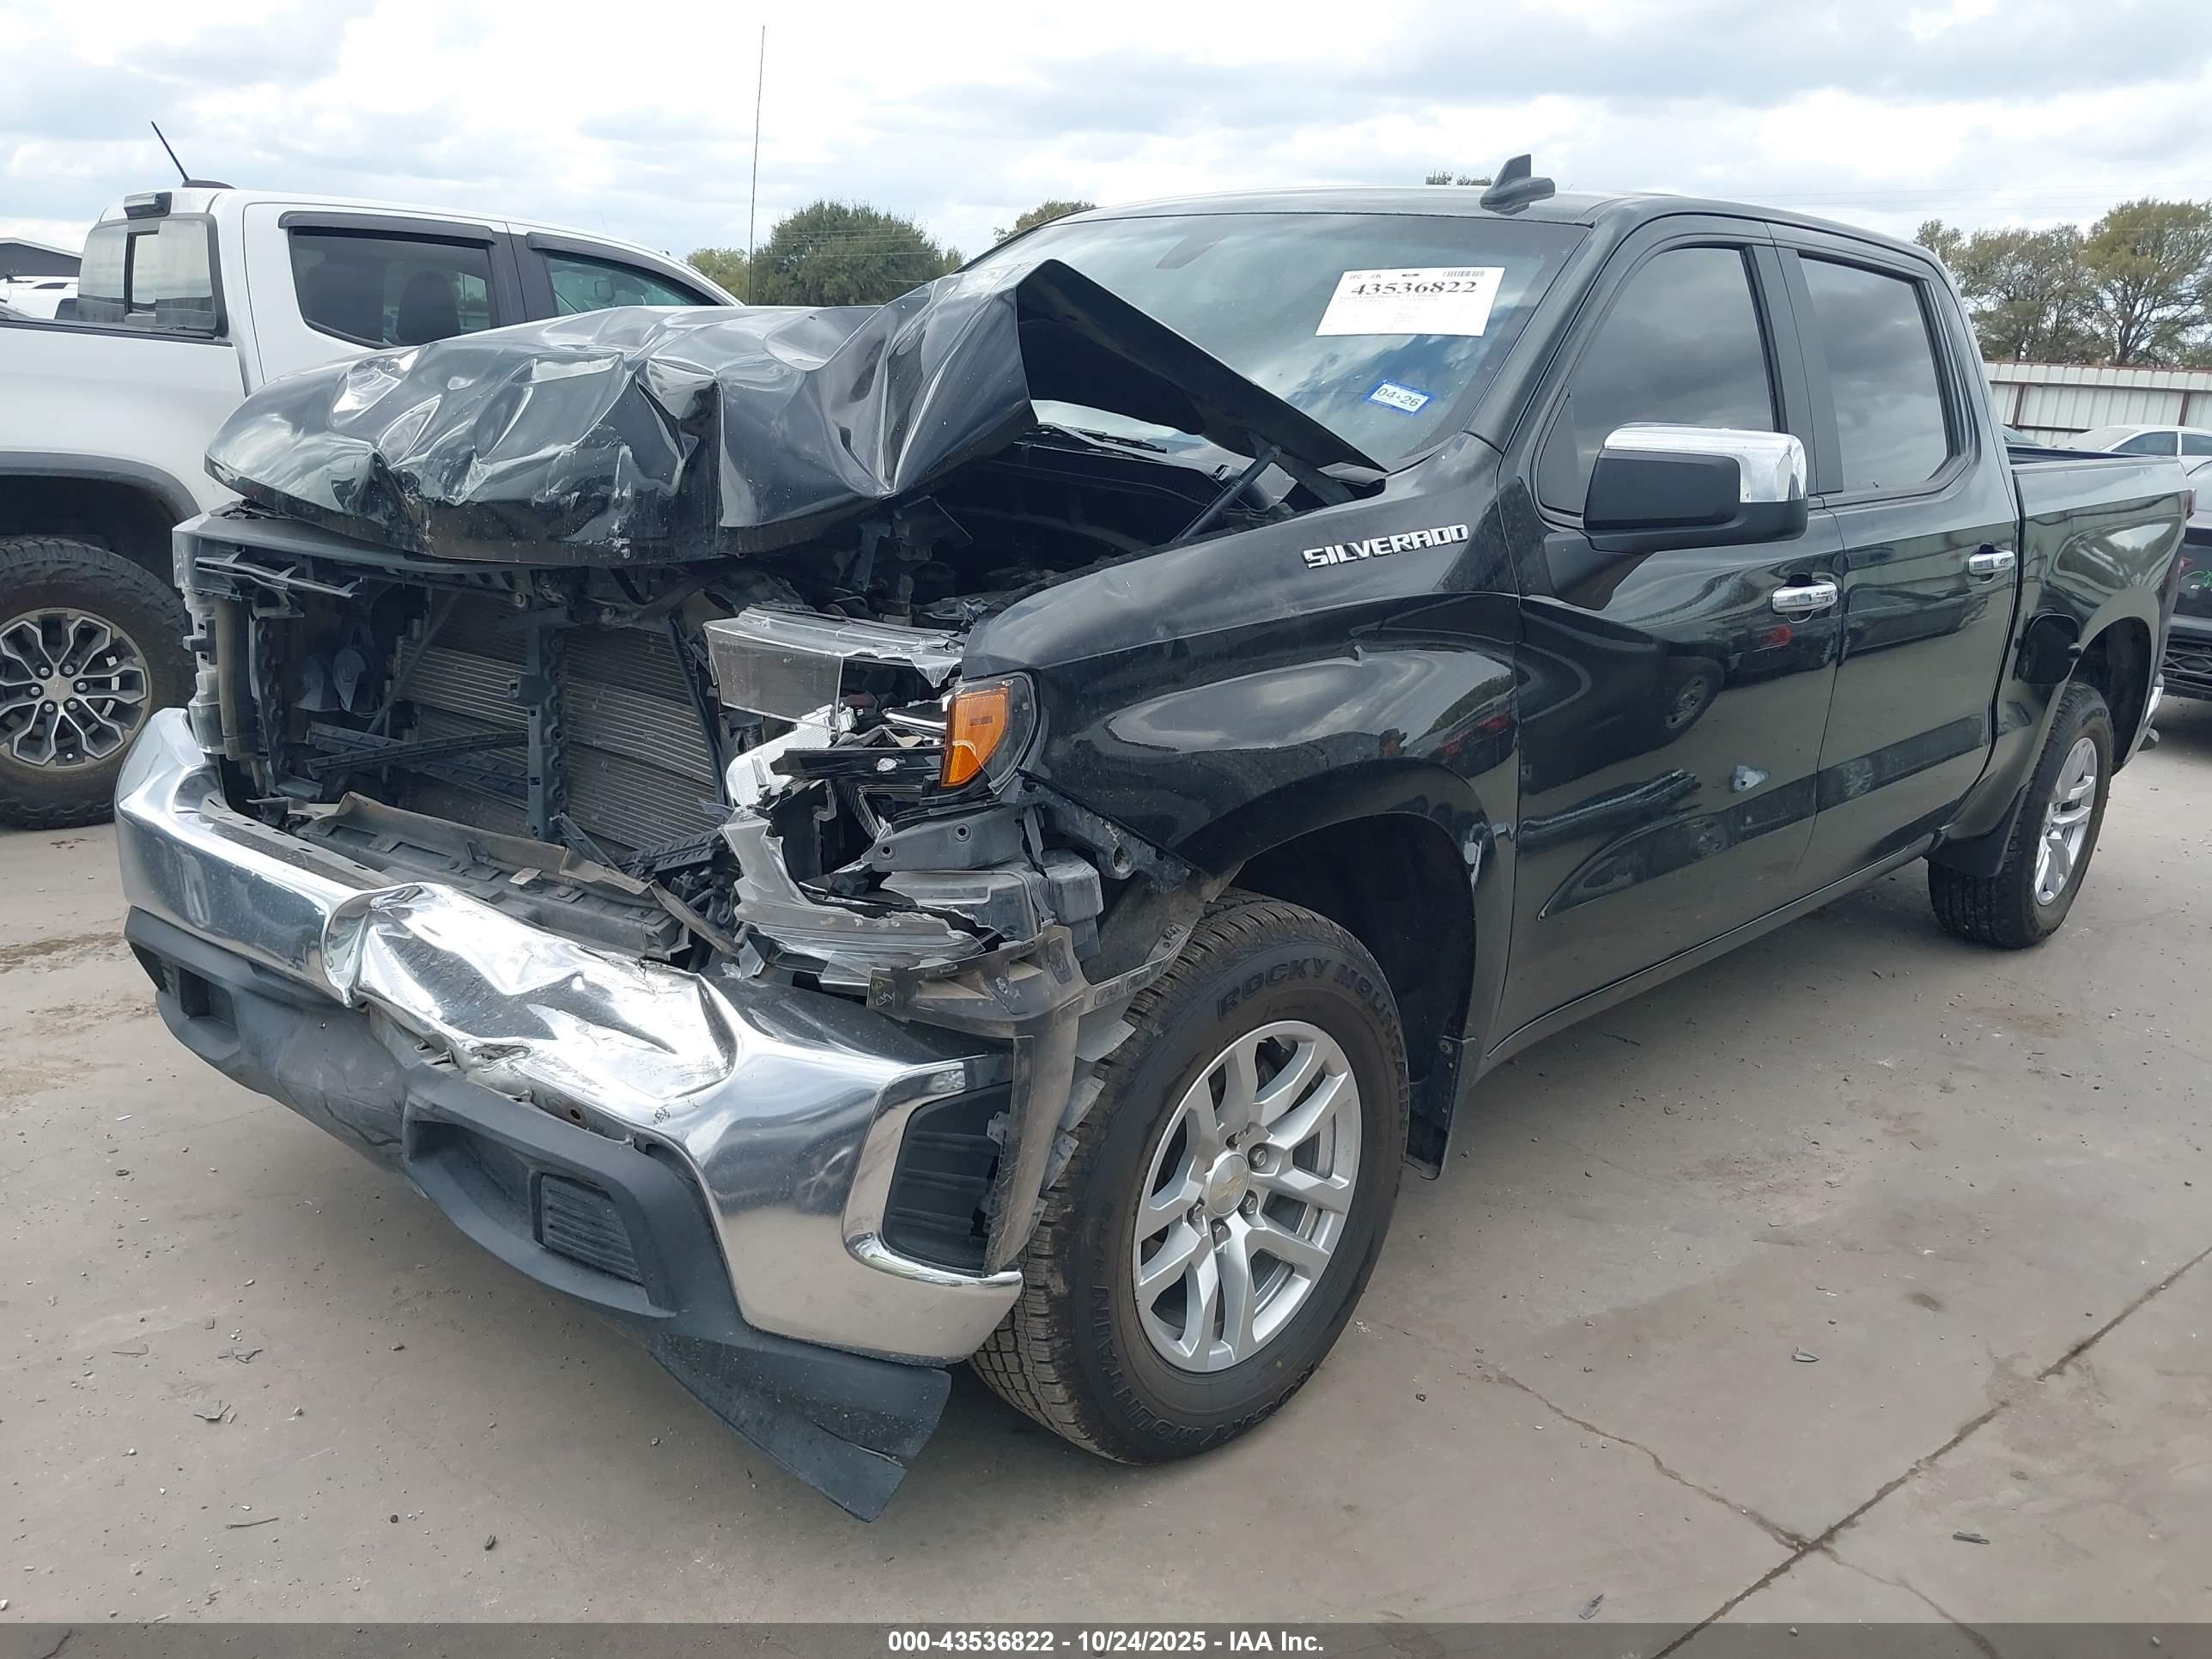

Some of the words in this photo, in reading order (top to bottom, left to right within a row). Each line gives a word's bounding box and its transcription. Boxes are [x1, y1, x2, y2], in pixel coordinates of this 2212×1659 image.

[1351, 281, 1477, 295] 43536822
[1303, 524, 1469, 568] SILVERADO
[1216, 956, 1333, 1023] ROCKY
